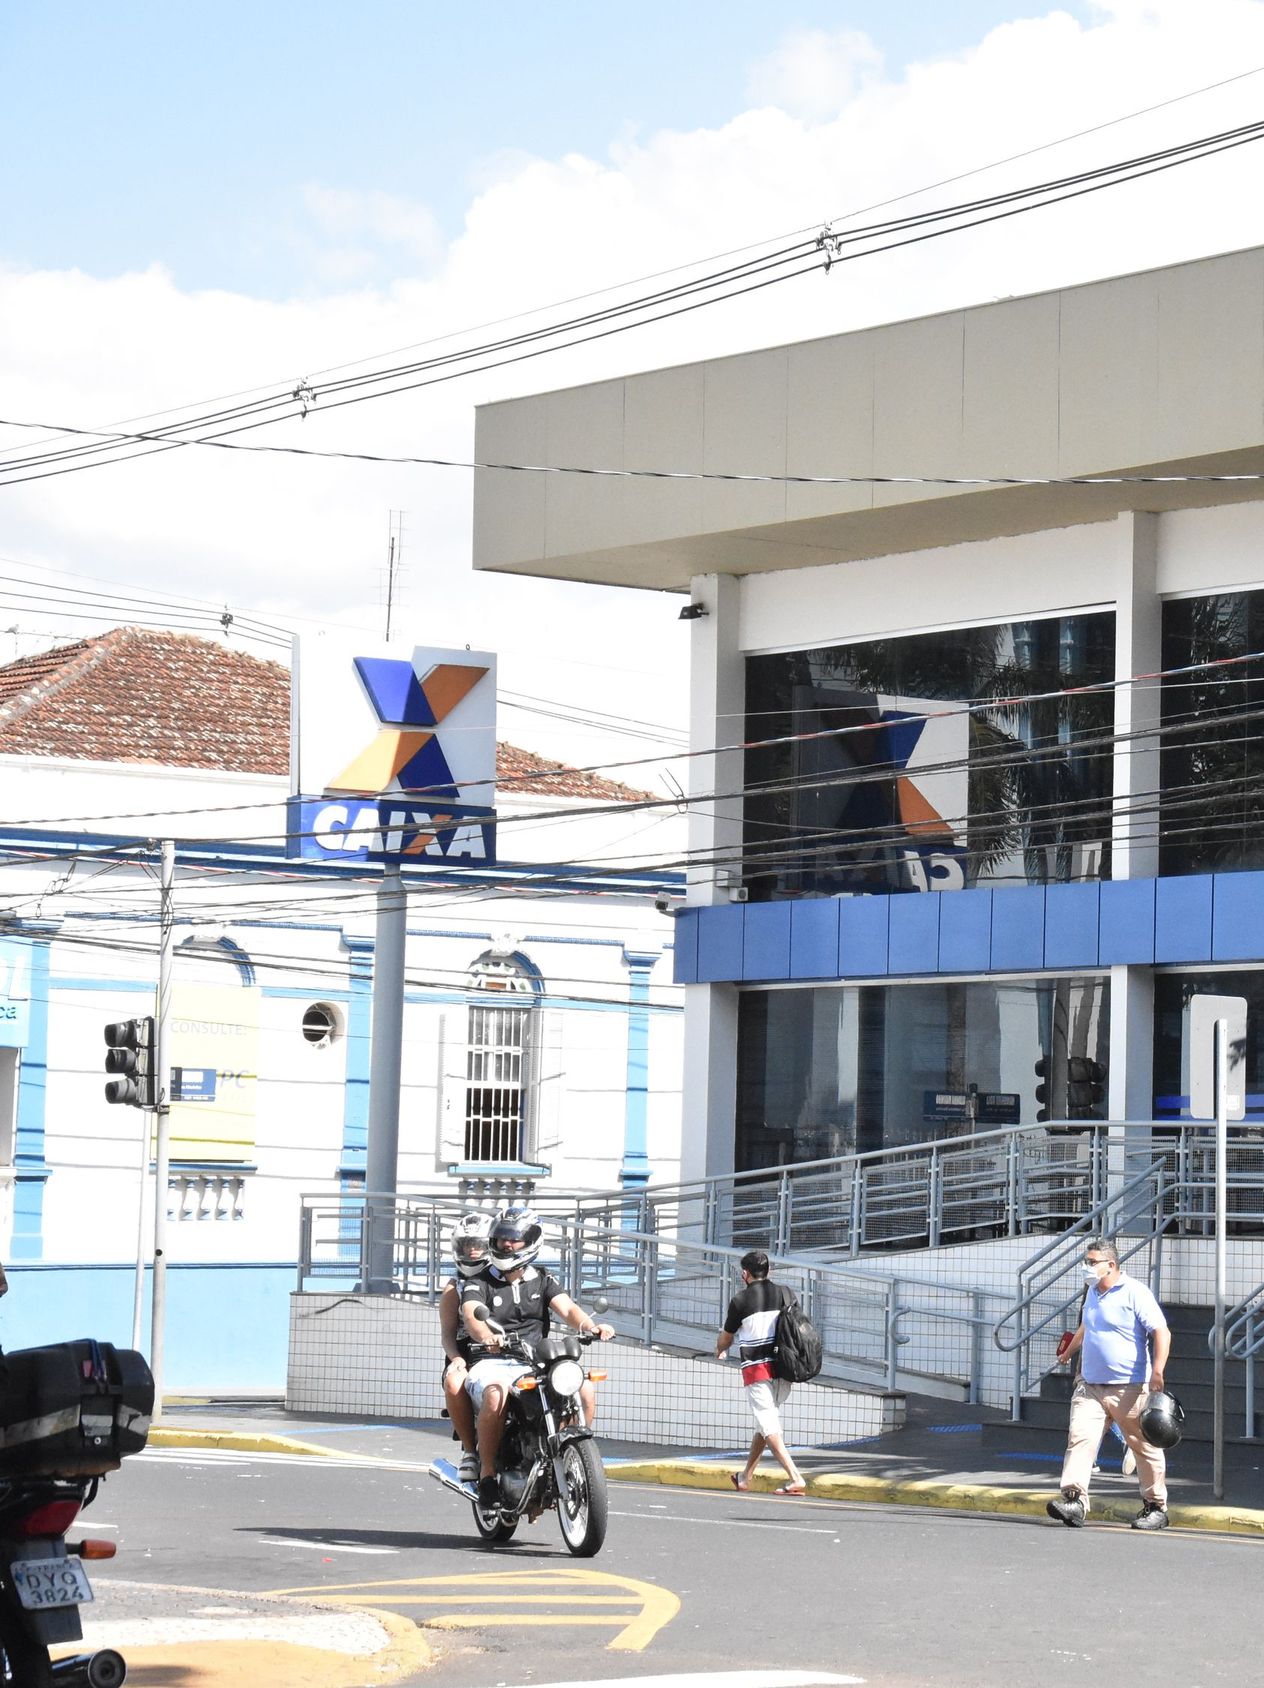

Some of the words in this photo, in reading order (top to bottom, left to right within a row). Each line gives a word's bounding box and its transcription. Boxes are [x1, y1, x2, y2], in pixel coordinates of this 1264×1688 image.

[313, 805, 487, 859] CAIXA
[170, 1021, 247, 1036] CONSULTE:
[219, 1069, 249, 1089] PC
[26, 1571, 78, 1589] DYQ
[30, 1585, 84, 1605] 3824
